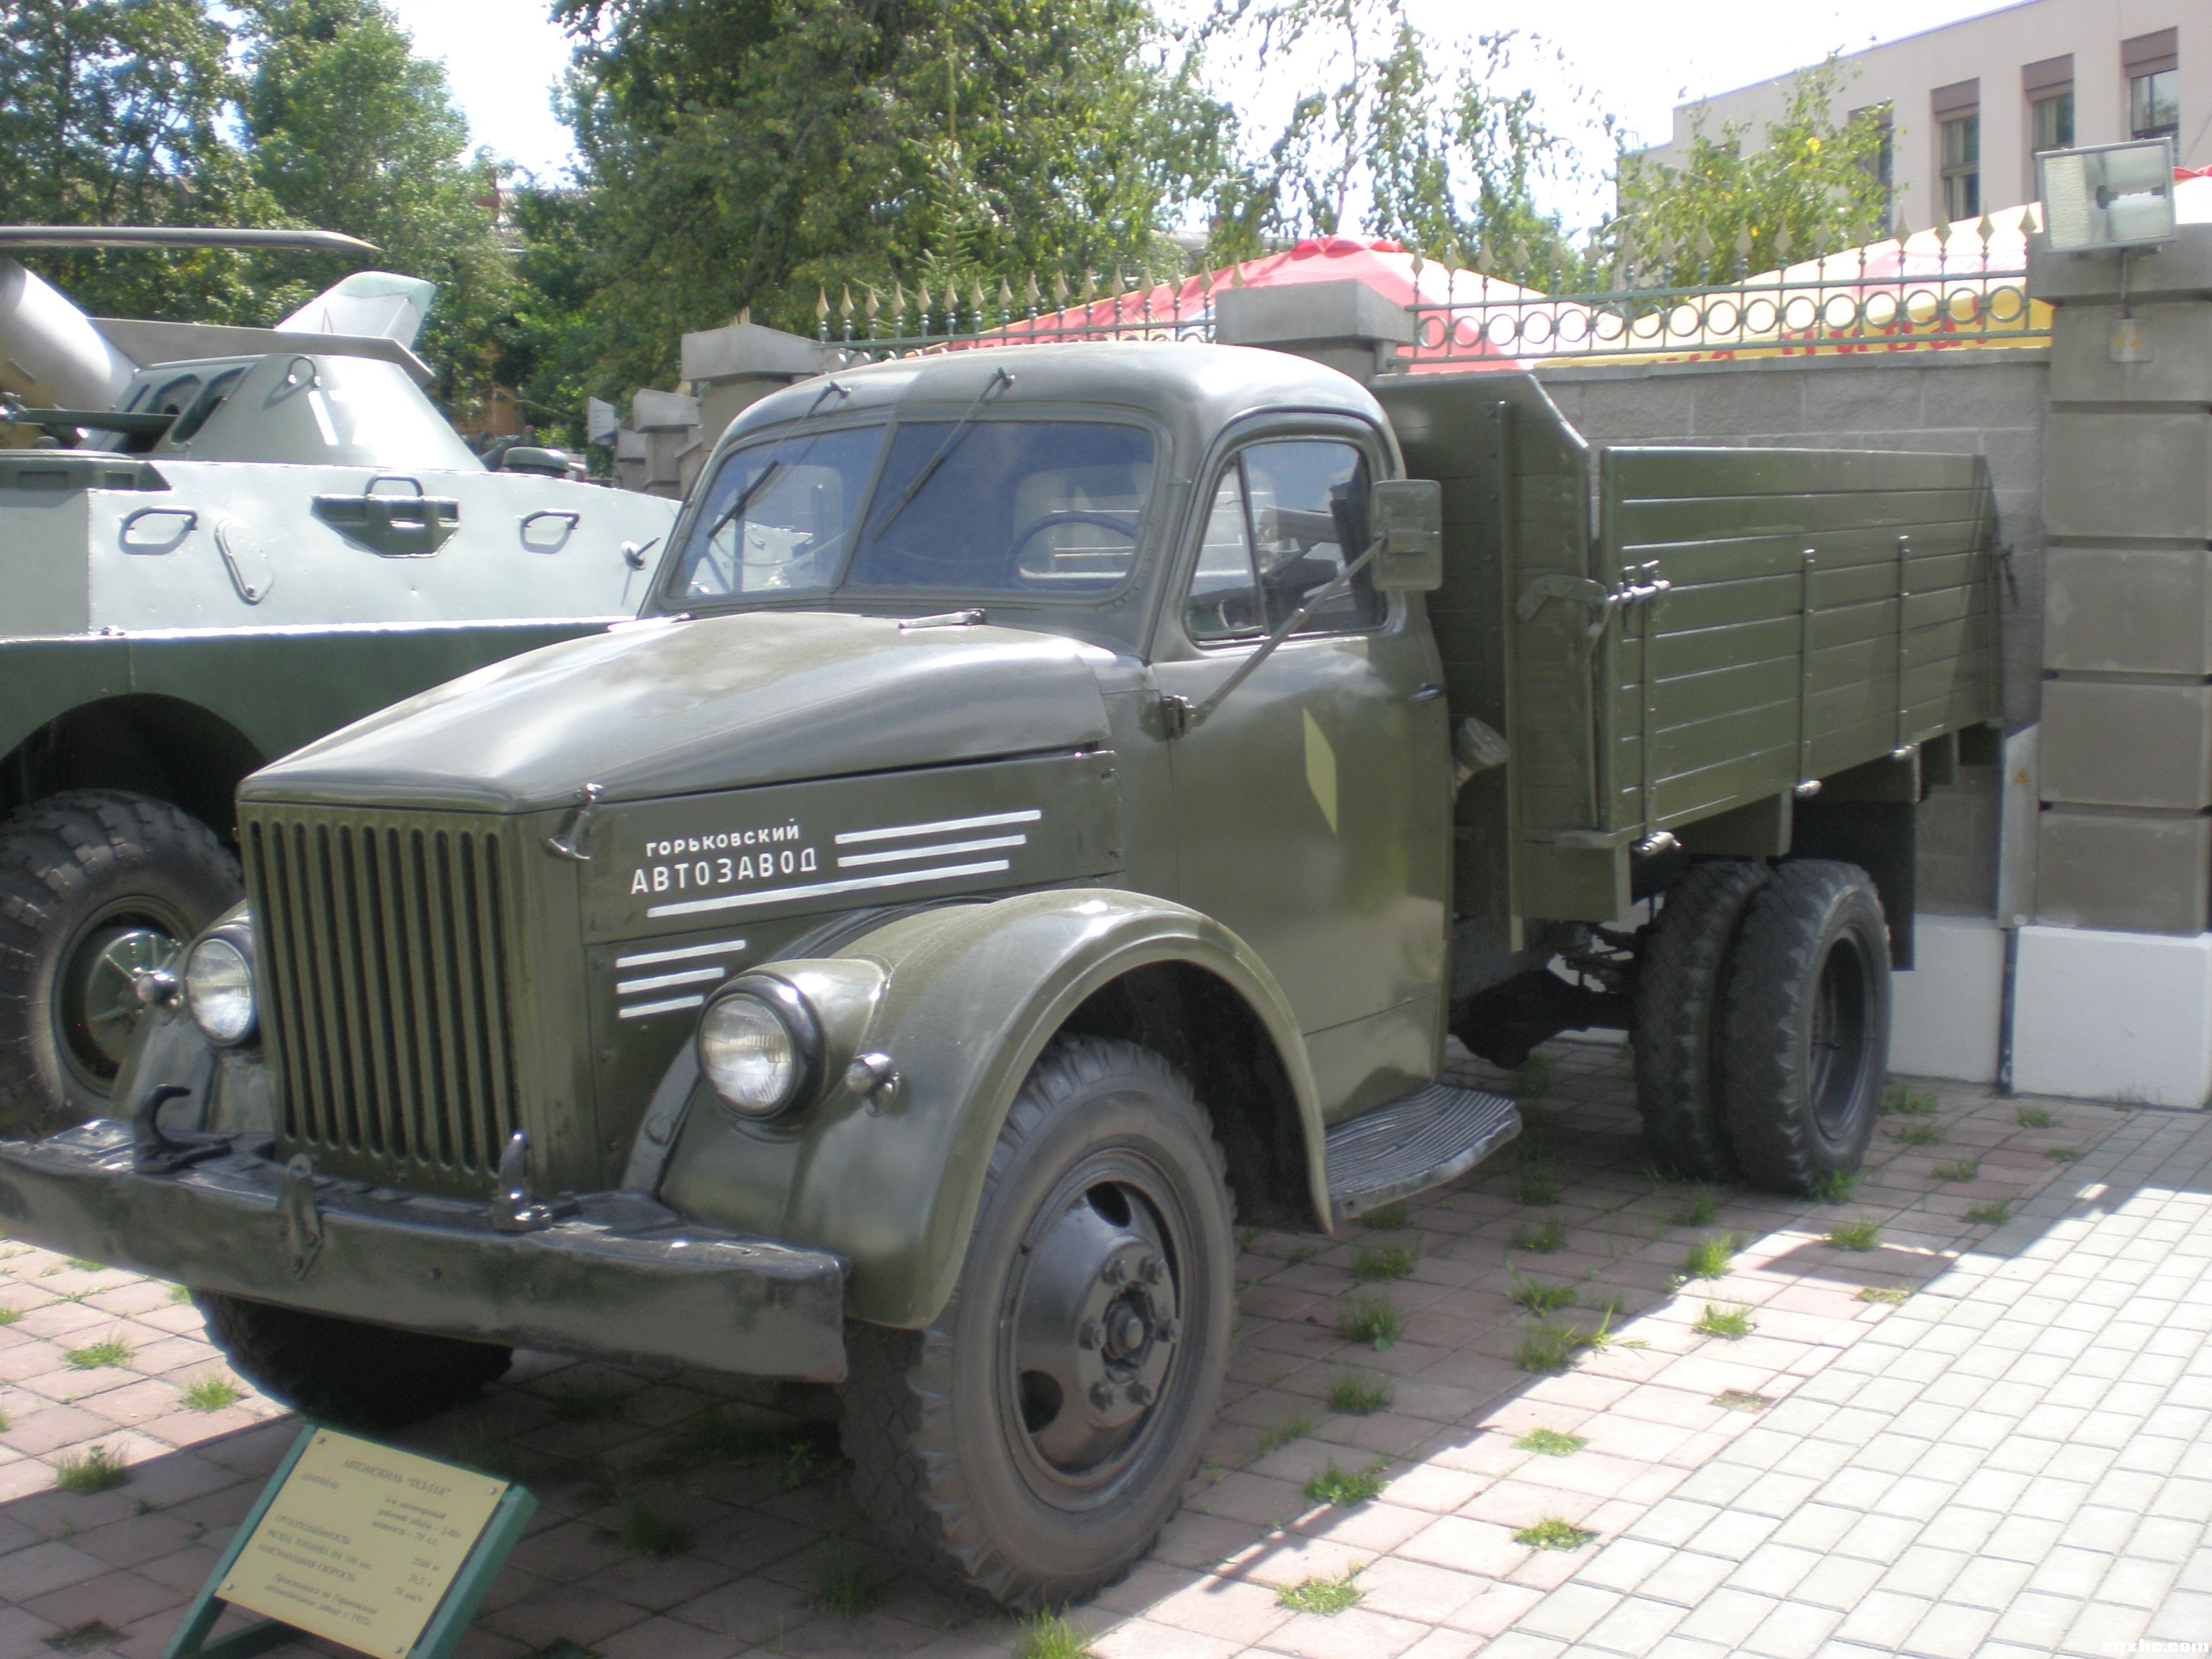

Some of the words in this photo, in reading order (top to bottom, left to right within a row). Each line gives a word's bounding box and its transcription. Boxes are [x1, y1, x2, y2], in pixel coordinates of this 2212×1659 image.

[645, 818, 800, 857] ГОРЬКОВСКИЙ
[631, 848, 818, 894] АВТОЗАВОД
[342, 1459, 405, 1483] АВТОМОБИЛЬ
